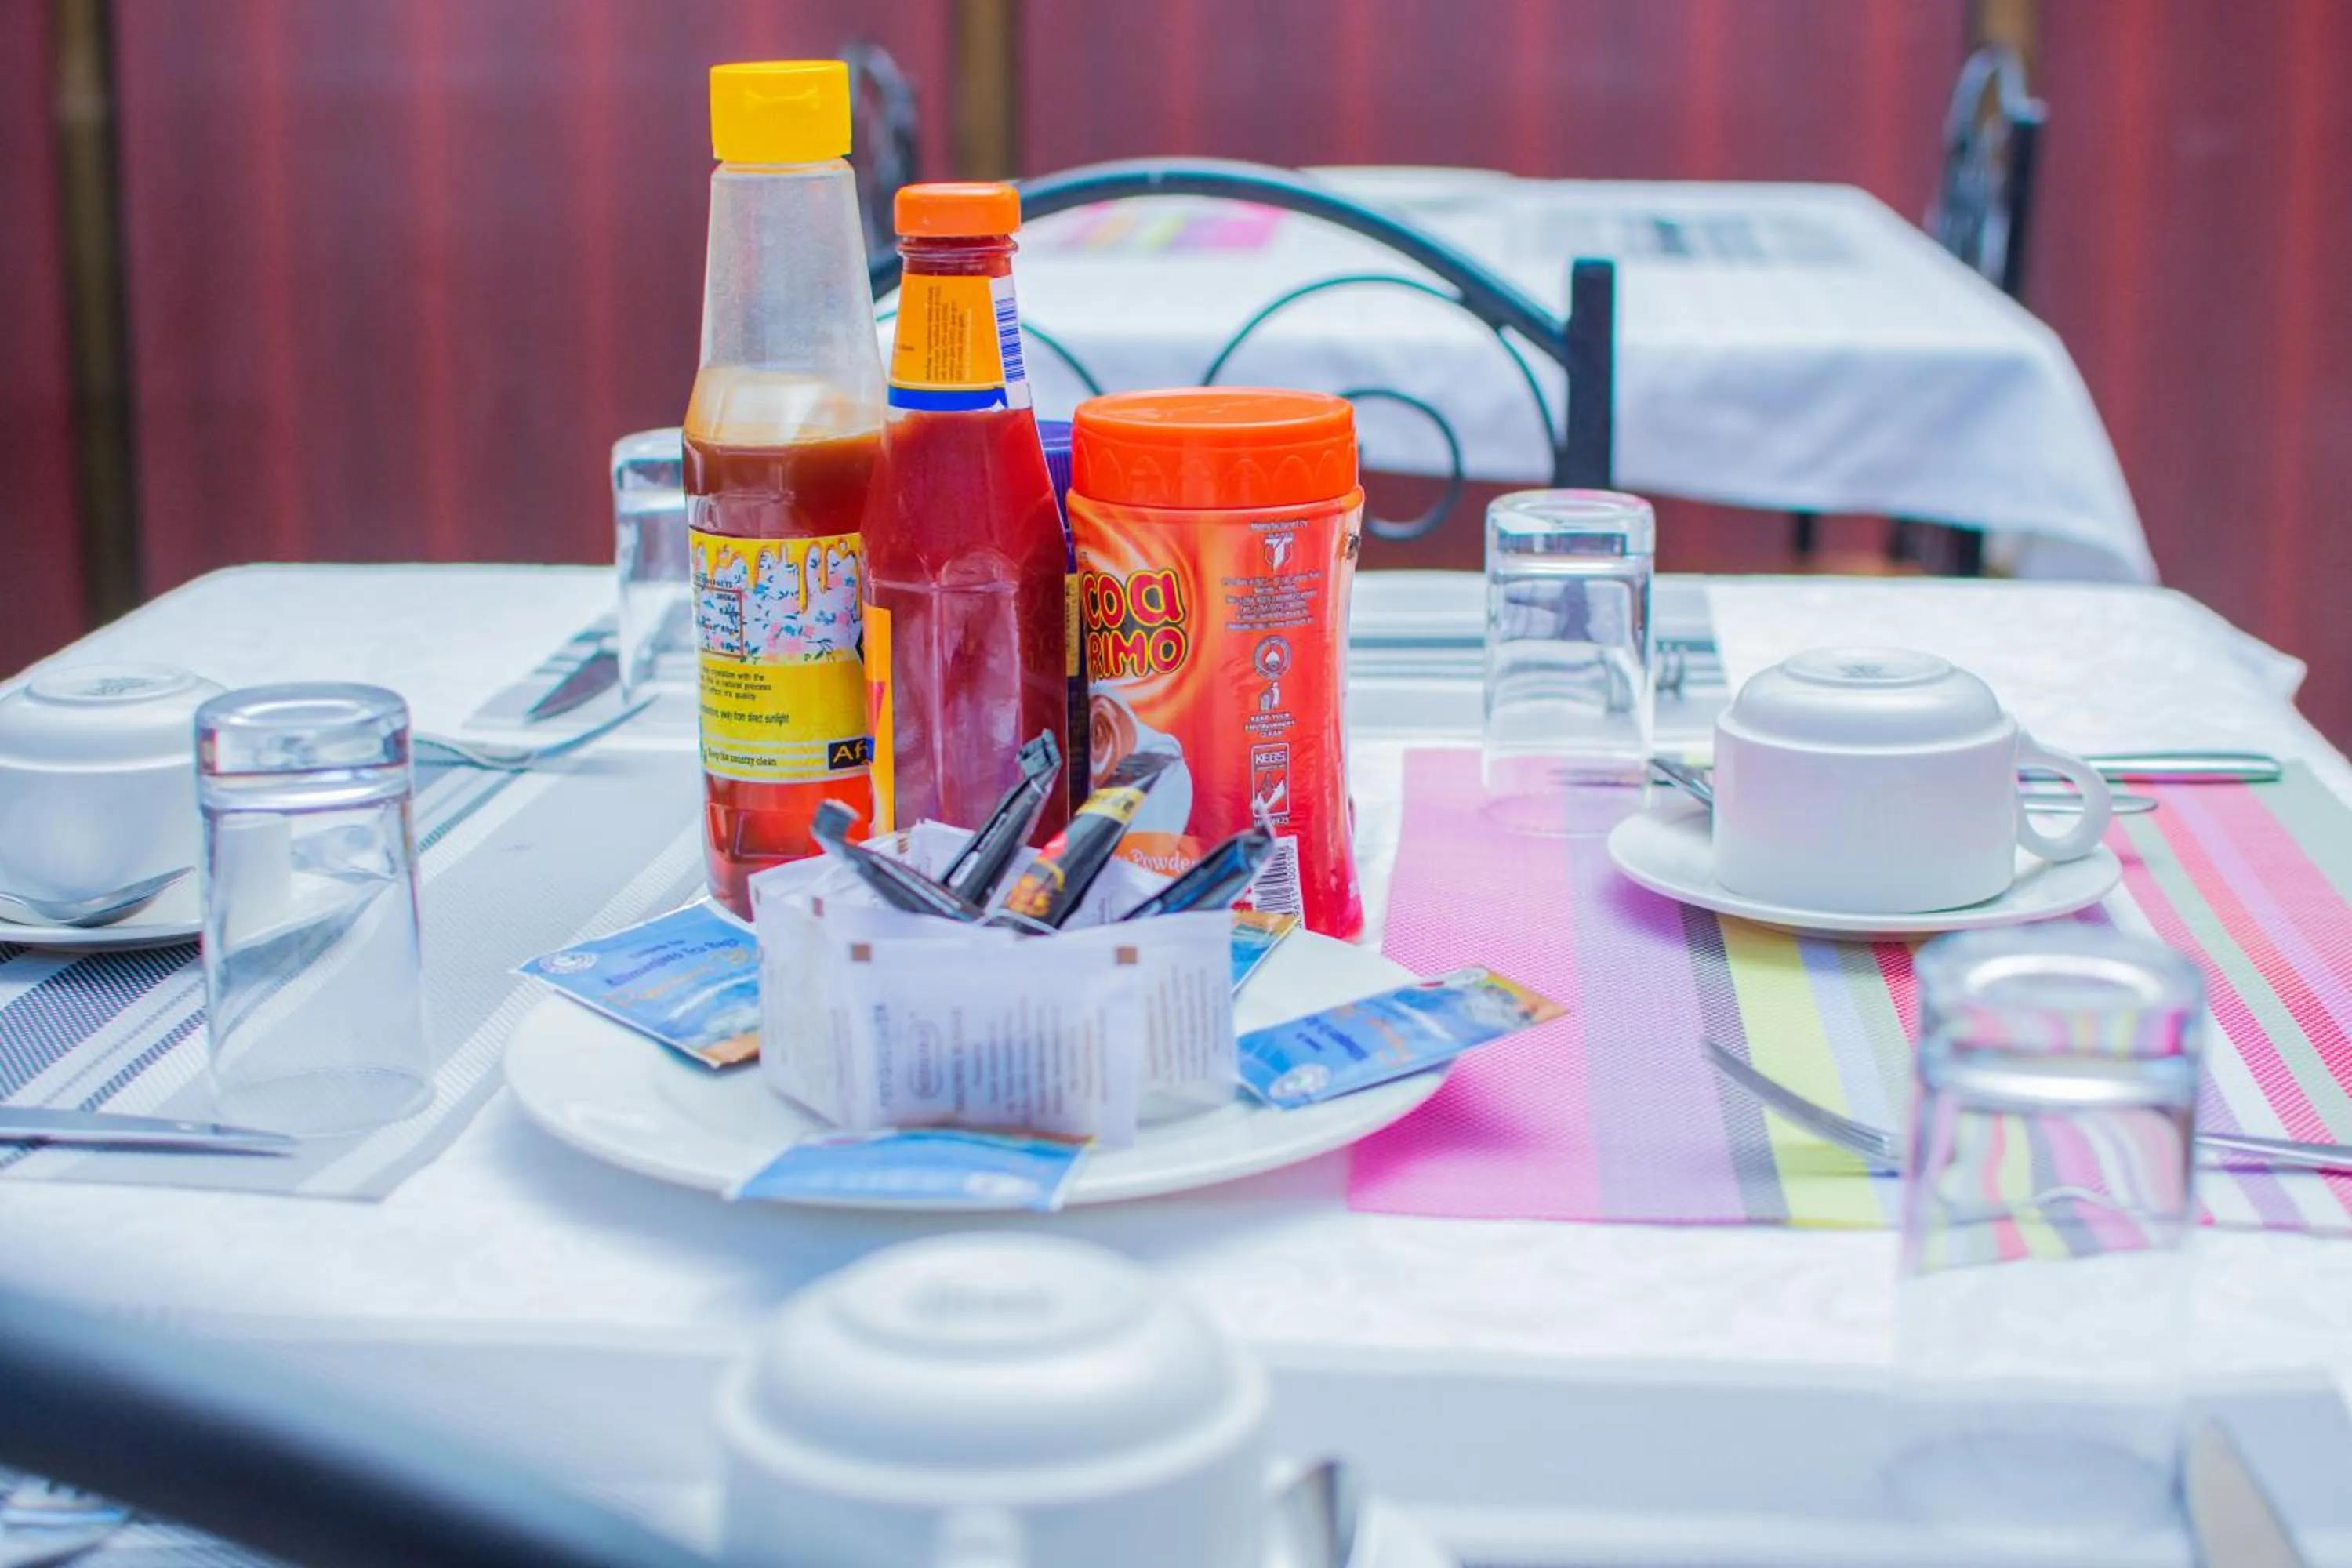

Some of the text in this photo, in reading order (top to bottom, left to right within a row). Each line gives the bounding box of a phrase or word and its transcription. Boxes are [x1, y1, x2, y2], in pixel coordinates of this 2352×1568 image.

[1087, 626, 1188, 682] RIMO
[832, 739, 868, 764] Af
[1255, 751, 1286, 764] KEBS
